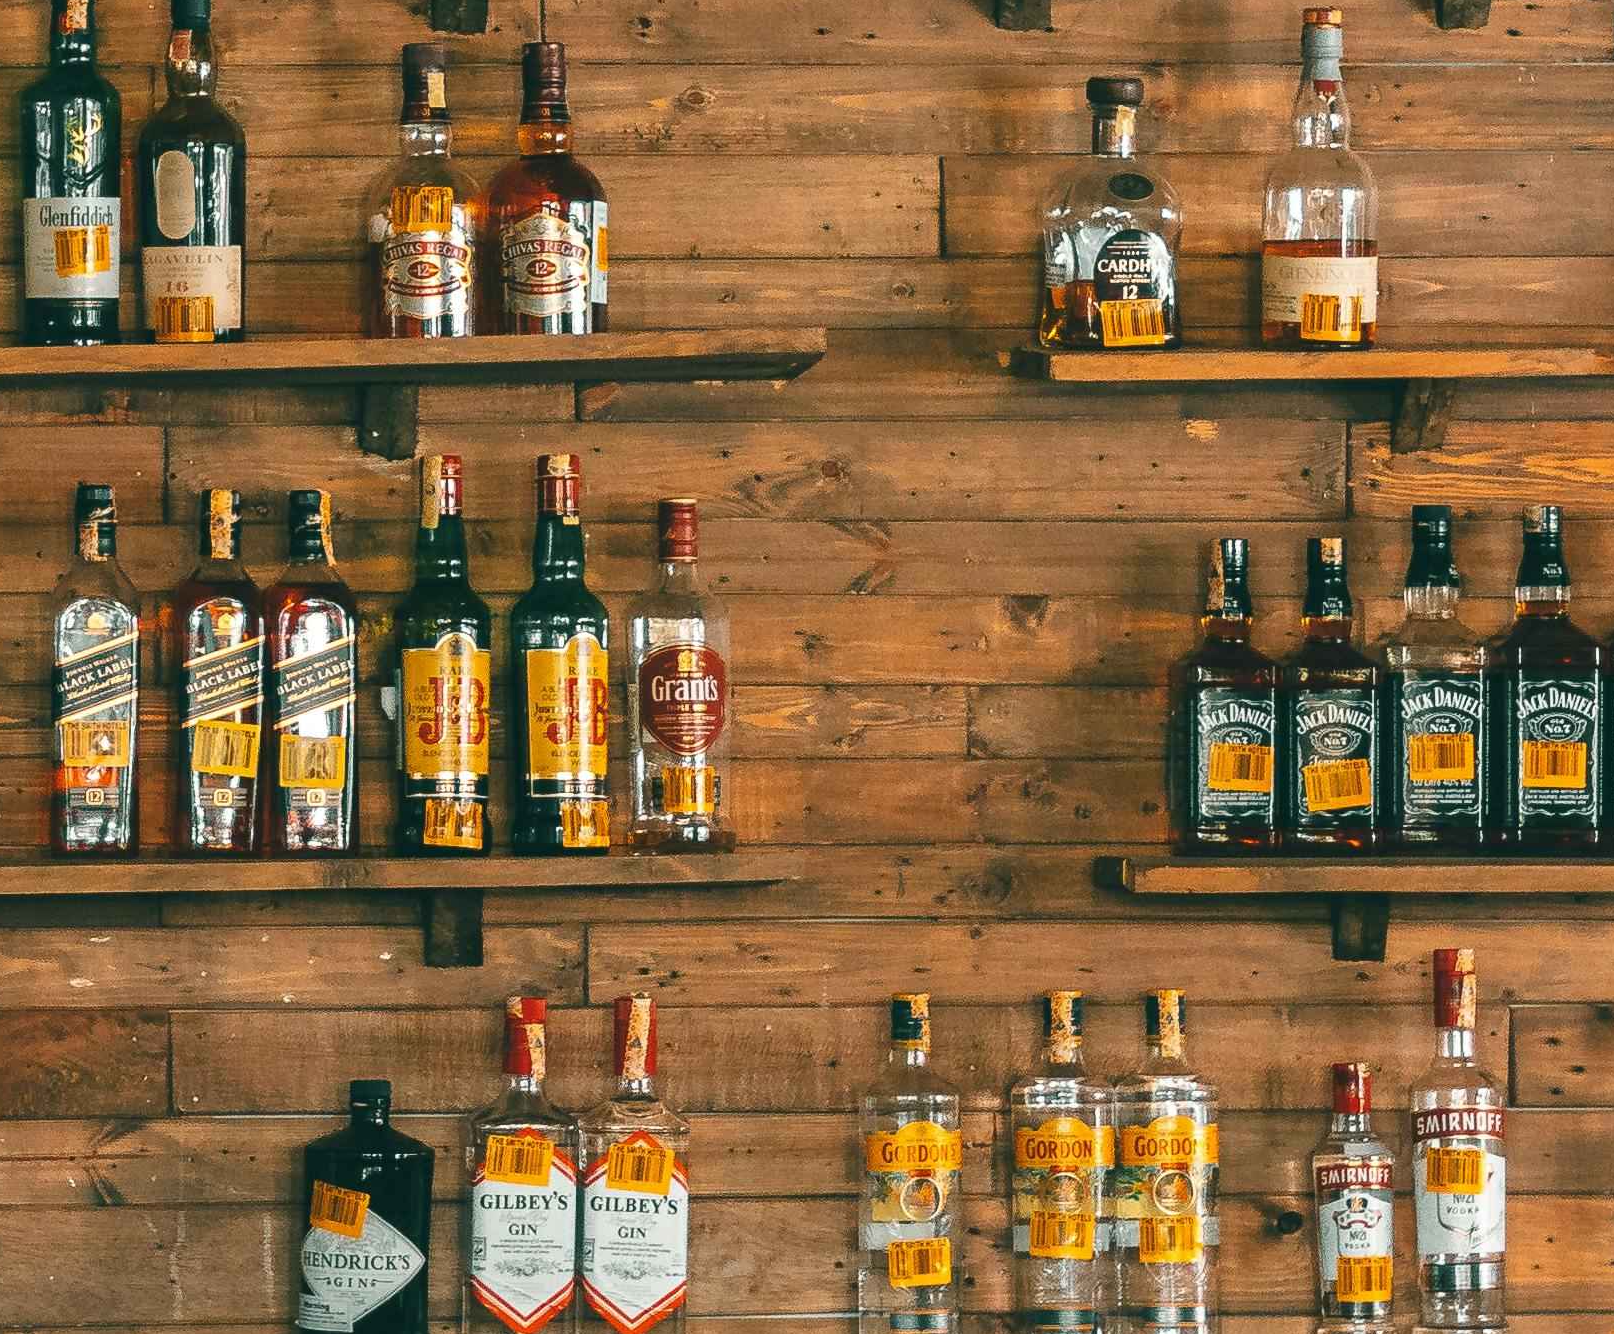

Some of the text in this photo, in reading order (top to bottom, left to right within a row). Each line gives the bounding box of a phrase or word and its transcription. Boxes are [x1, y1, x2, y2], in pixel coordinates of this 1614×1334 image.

[40, 205, 113, 228] Glenfiddich
[384, 241, 466, 264] CHIVAS REGAL
[501, 240, 585, 262] CHIVAS REGAL
[417, 262, 431, 276] 12
[535, 261, 548, 275] 12
[165, 281, 189, 293] 16
[1122, 285, 1138, 299] 12
[97, 658, 135, 678] LABEL
[227, 660, 263, 679] LABEL
[318, 660, 355, 680] LABEL
[651, 674, 719, 703] Grant's
[1401, 692, 1433, 718] JACK
[1517, 695, 1547, 718] JACK
[1197, 709, 1228, 734] JACK
[1297, 709, 1327, 734] JACK
[1544, 724, 1570, 734] No.7
[1417, 1111, 1503, 1135] SMIRNOFF
[1026, 1137, 1092, 1159] GORDON
[1134, 1135, 1198, 1157] GORDON
[1321, 1166, 1391, 1186] SMIRNOFF
[480, 1191, 569, 1211] GILBEY'S
[590, 1195, 679, 1215] GILBEY'S
[508, 1223, 538, 1236] GIN
[618, 1227, 647, 1239] GIN
[304, 1250, 411, 1271] HENDRICK'S
[333, 1276, 369, 1288] GIN
